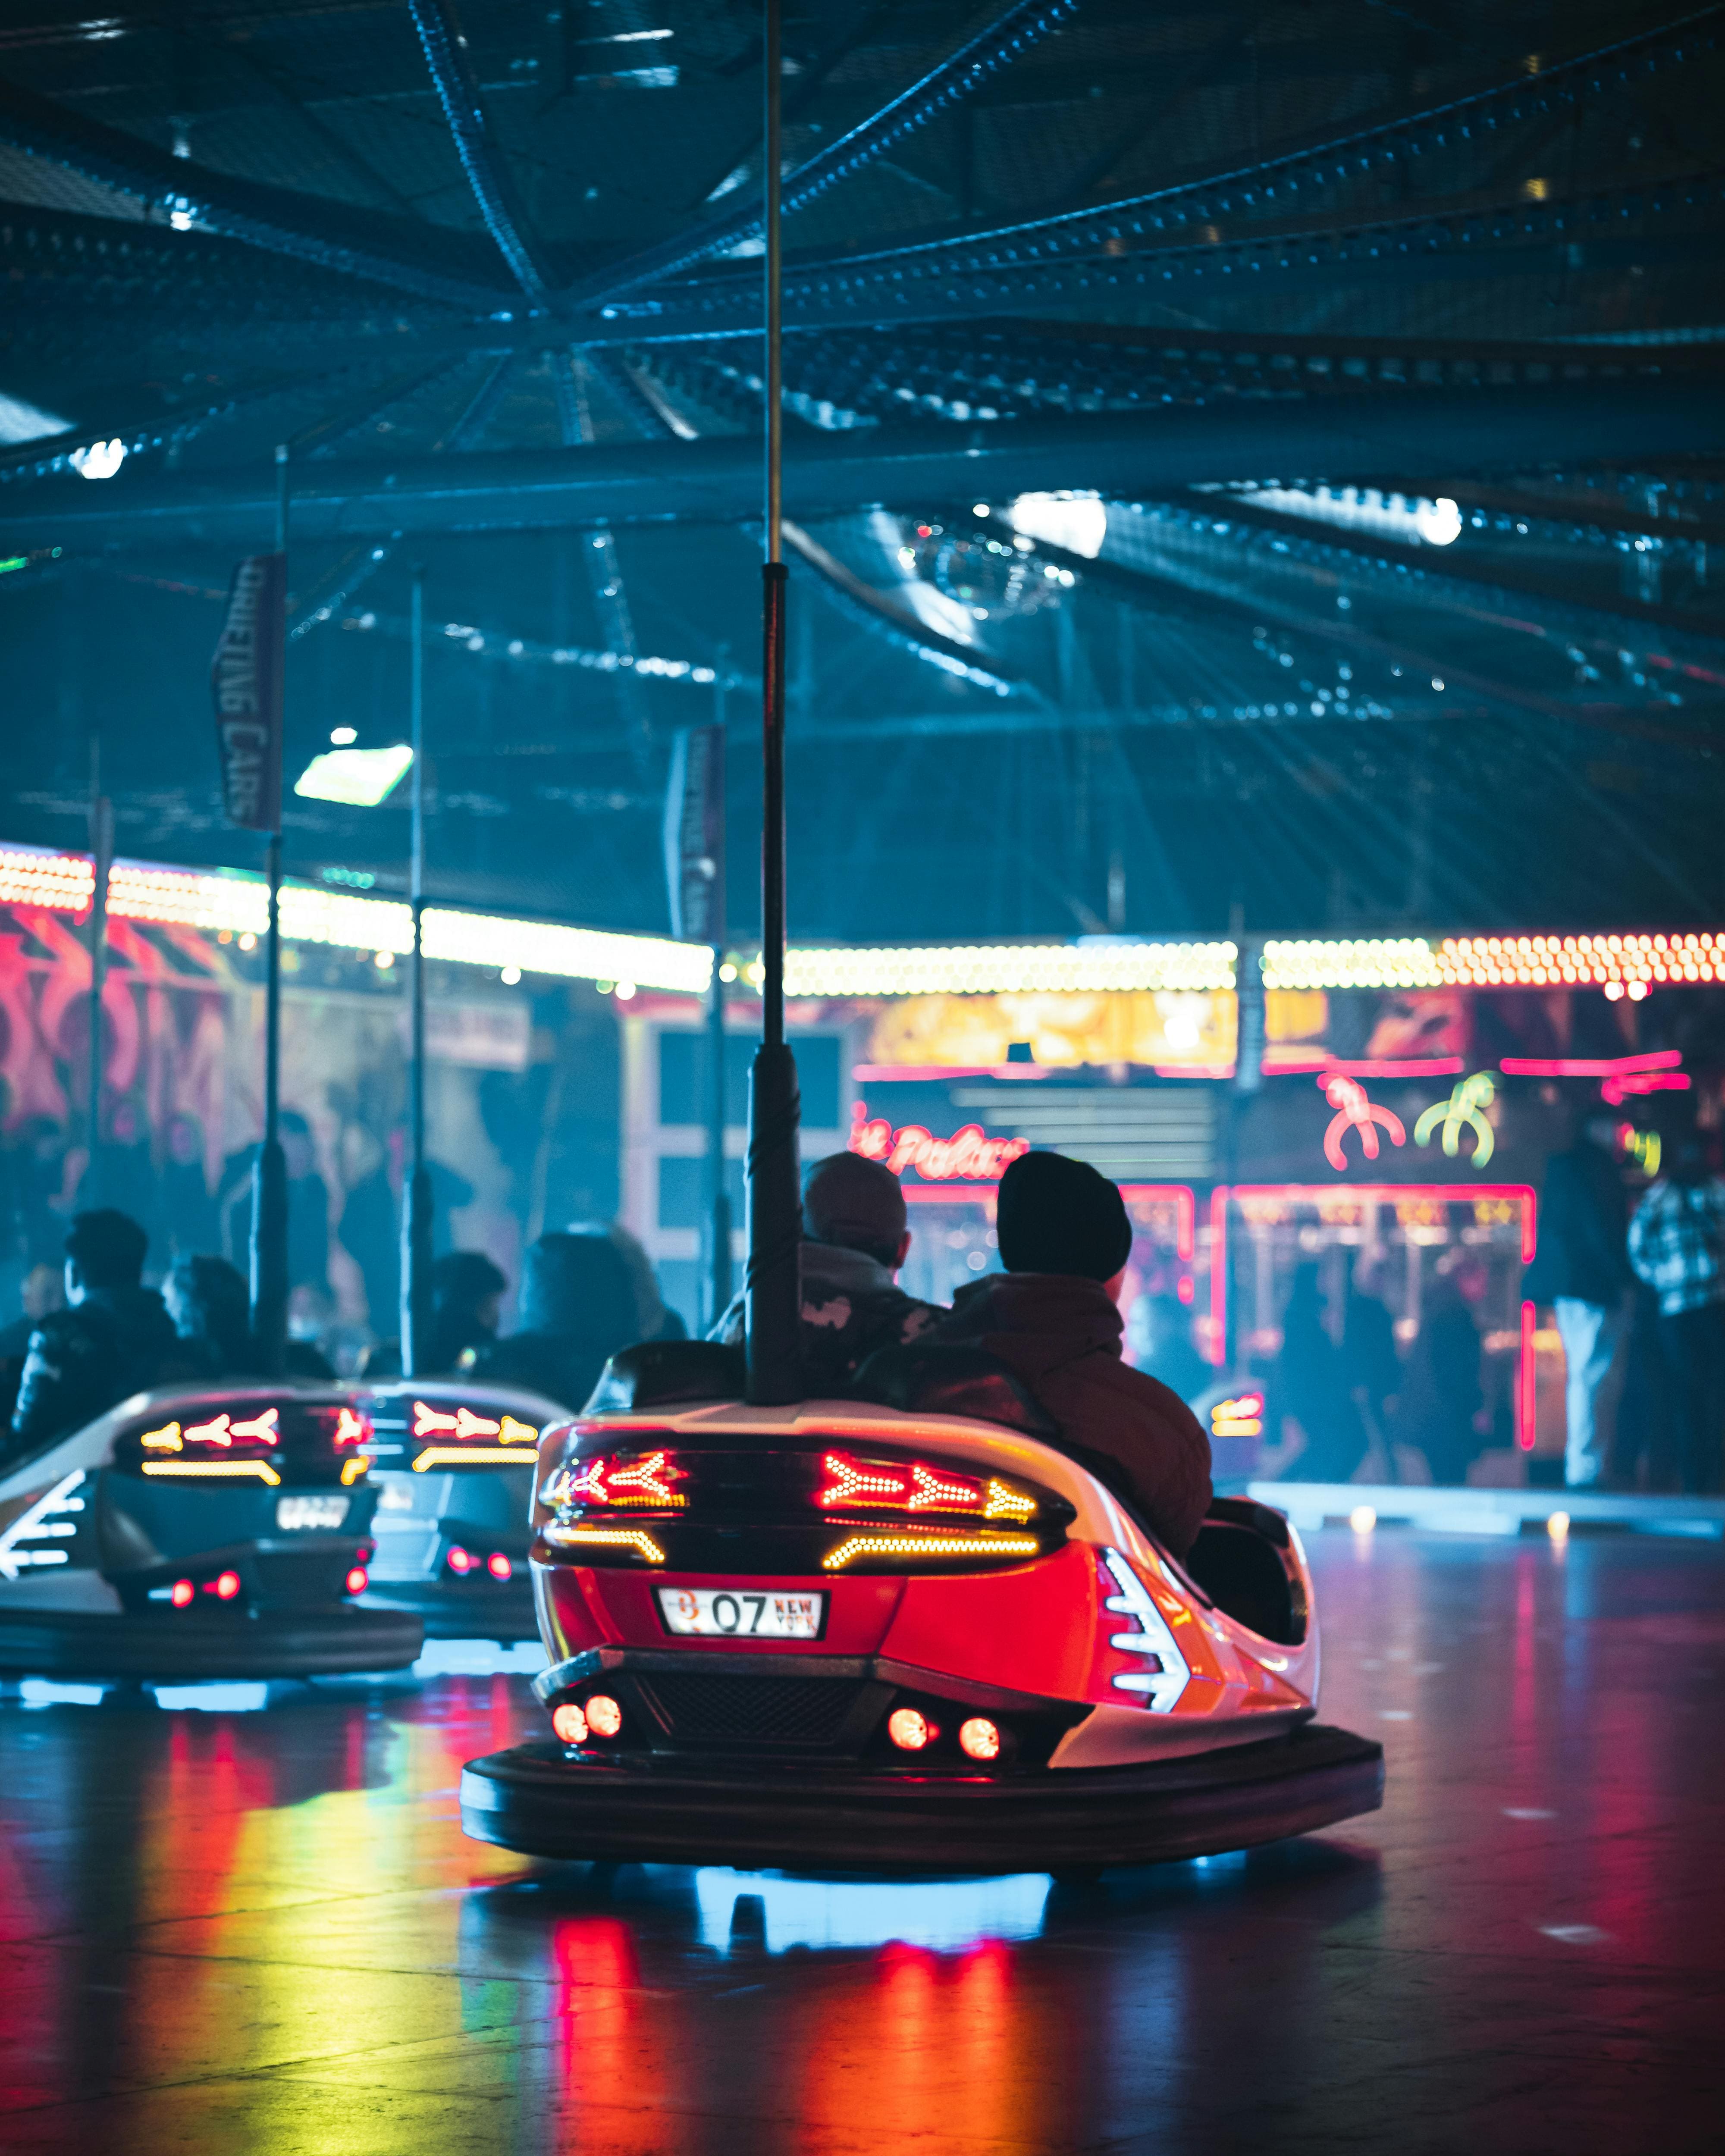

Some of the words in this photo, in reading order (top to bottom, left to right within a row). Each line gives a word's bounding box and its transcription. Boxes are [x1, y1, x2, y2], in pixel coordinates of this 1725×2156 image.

[222, 722, 267, 819] CARS
[712, 1593, 767, 1633] 07
[774, 1599, 812, 1614] NEW
[777, 1615, 816, 1631] YORK
